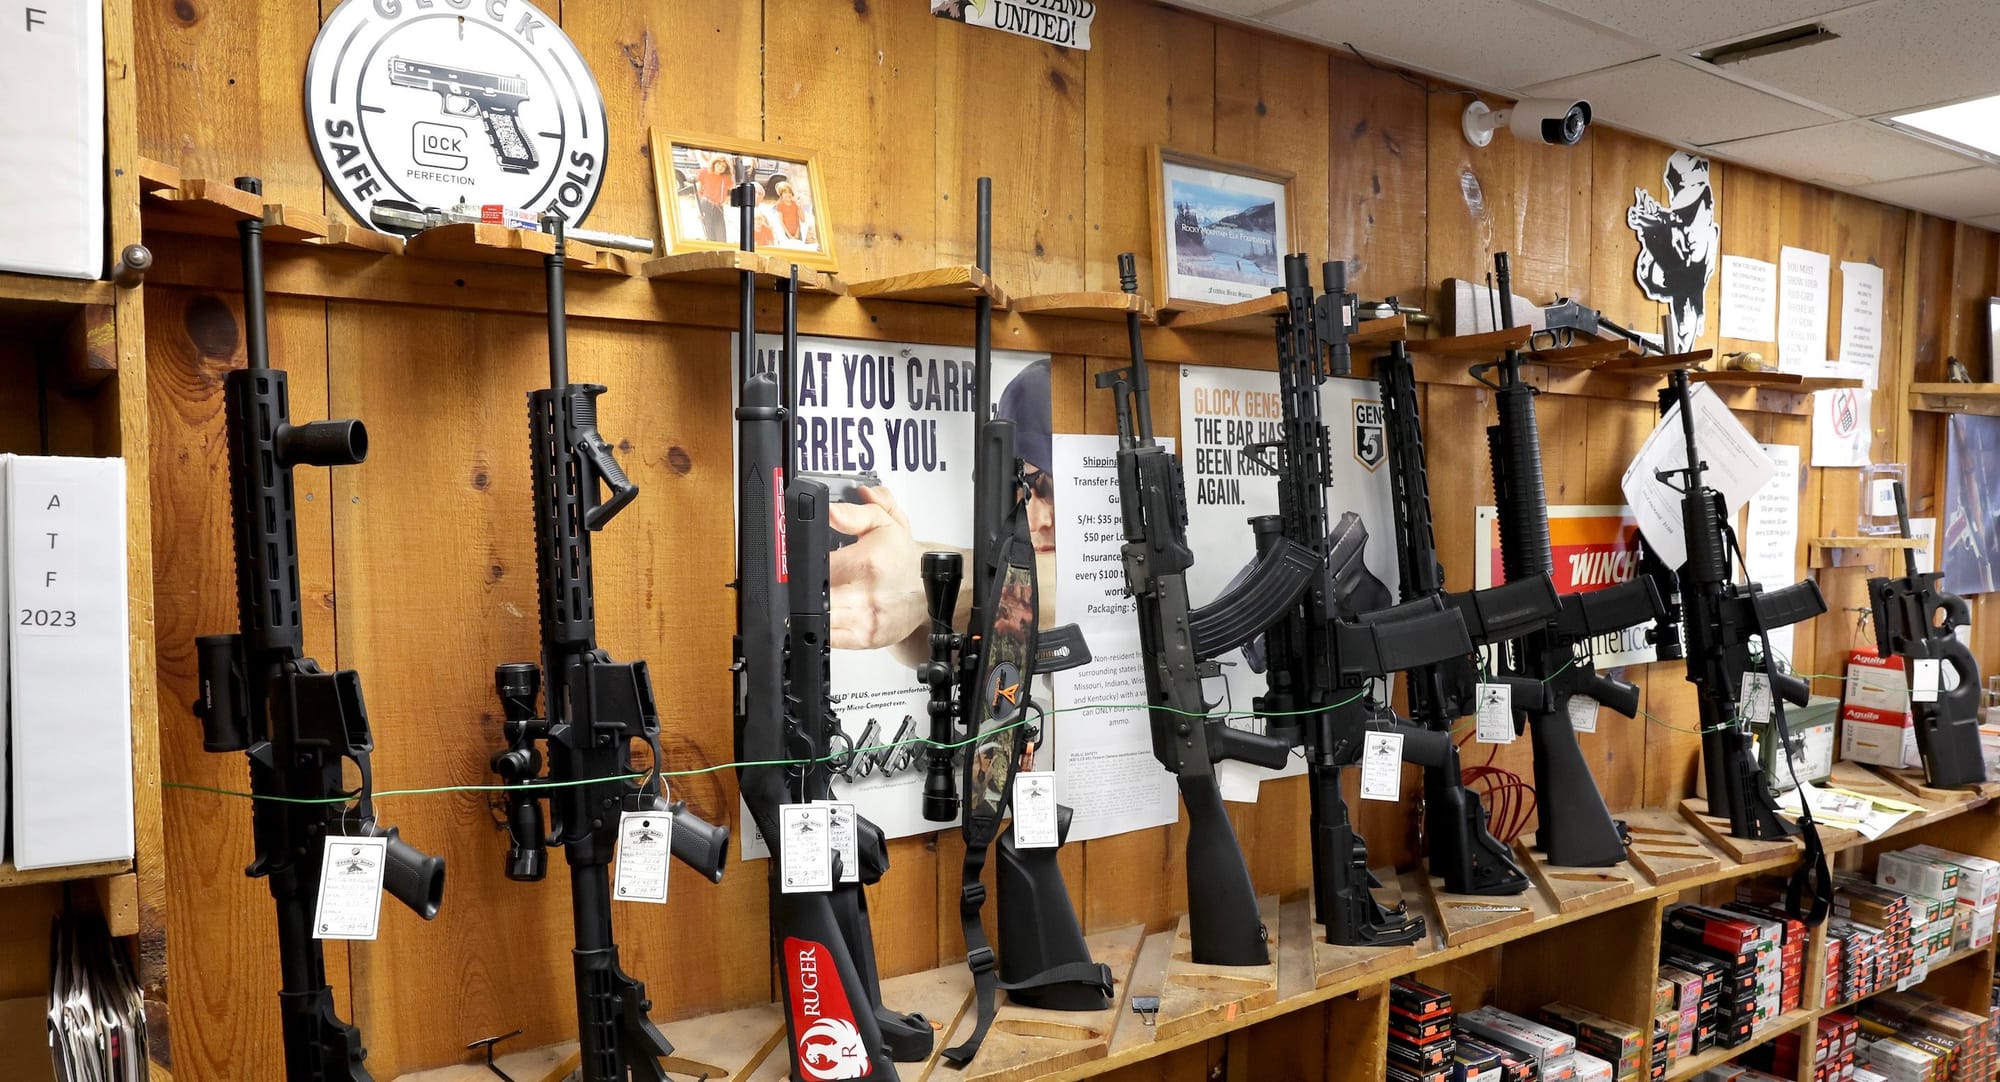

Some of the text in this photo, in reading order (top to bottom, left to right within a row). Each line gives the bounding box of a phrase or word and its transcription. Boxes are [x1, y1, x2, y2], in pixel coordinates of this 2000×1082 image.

[25, 8, 47, 32] F
[994, 1, 1076, 46] UNITED!
[325, 118, 382, 202] SAFE
[407, 169, 475, 186] PERFECTION
[546, 150, 595, 222] TOLS
[842, 353, 895, 410] YOU
[907, 356, 998, 413] CARR,
[1194, 387, 1281, 419] GLOCK GEN5
[1195, 418, 1222, 445] THE
[1227, 420, 1254, 446] BAR
[797, 416, 946, 472] RRIES YOU.
[1361, 428, 1380, 461] 5
[1196, 448, 1287, 477] BEEN RAISE
[1073, 476, 1119, 487] Transfer Fe
[1108, 494, 1120, 504] Gu
[1197, 478, 1245, 505] AGAIN.
[777, 476, 788, 575] RUGER
[1077, 514, 1096, 526] S/H:
[1097, 514, 1112, 525] $35
[1084, 532, 1125, 543] $50 per Lo
[1568, 547, 1644, 587] WINCH
[1075, 572, 1097, 582] every
[1098, 569, 1119, 580] $100
[1087, 603, 1130, 615] Packaging:
[20, 609, 77, 628] 2023
[1094, 653, 1135, 663] Non-resident
[1853, 654, 1886, 665] Aguila
[1078, 668, 1118, 678] surrounding
[1118, 665, 1136, 674] states
[881, 689, 896, 697] most
[1073, 682, 1104, 692] Missouri,
[1104, 679, 1130, 689] Indiana,
[1073, 696, 1086, 705] and
[1087, 692, 1119, 703] Kentucky)
[1119, 690, 1134, 699] with
[847, 701, 893, 712] Micro-Compact
[1082, 708, 1094, 717] can
[1847, 709, 1880, 720] Aguila
[799, 946, 821, 1017] RUGER
[841, 1045, 857, 1059] R
